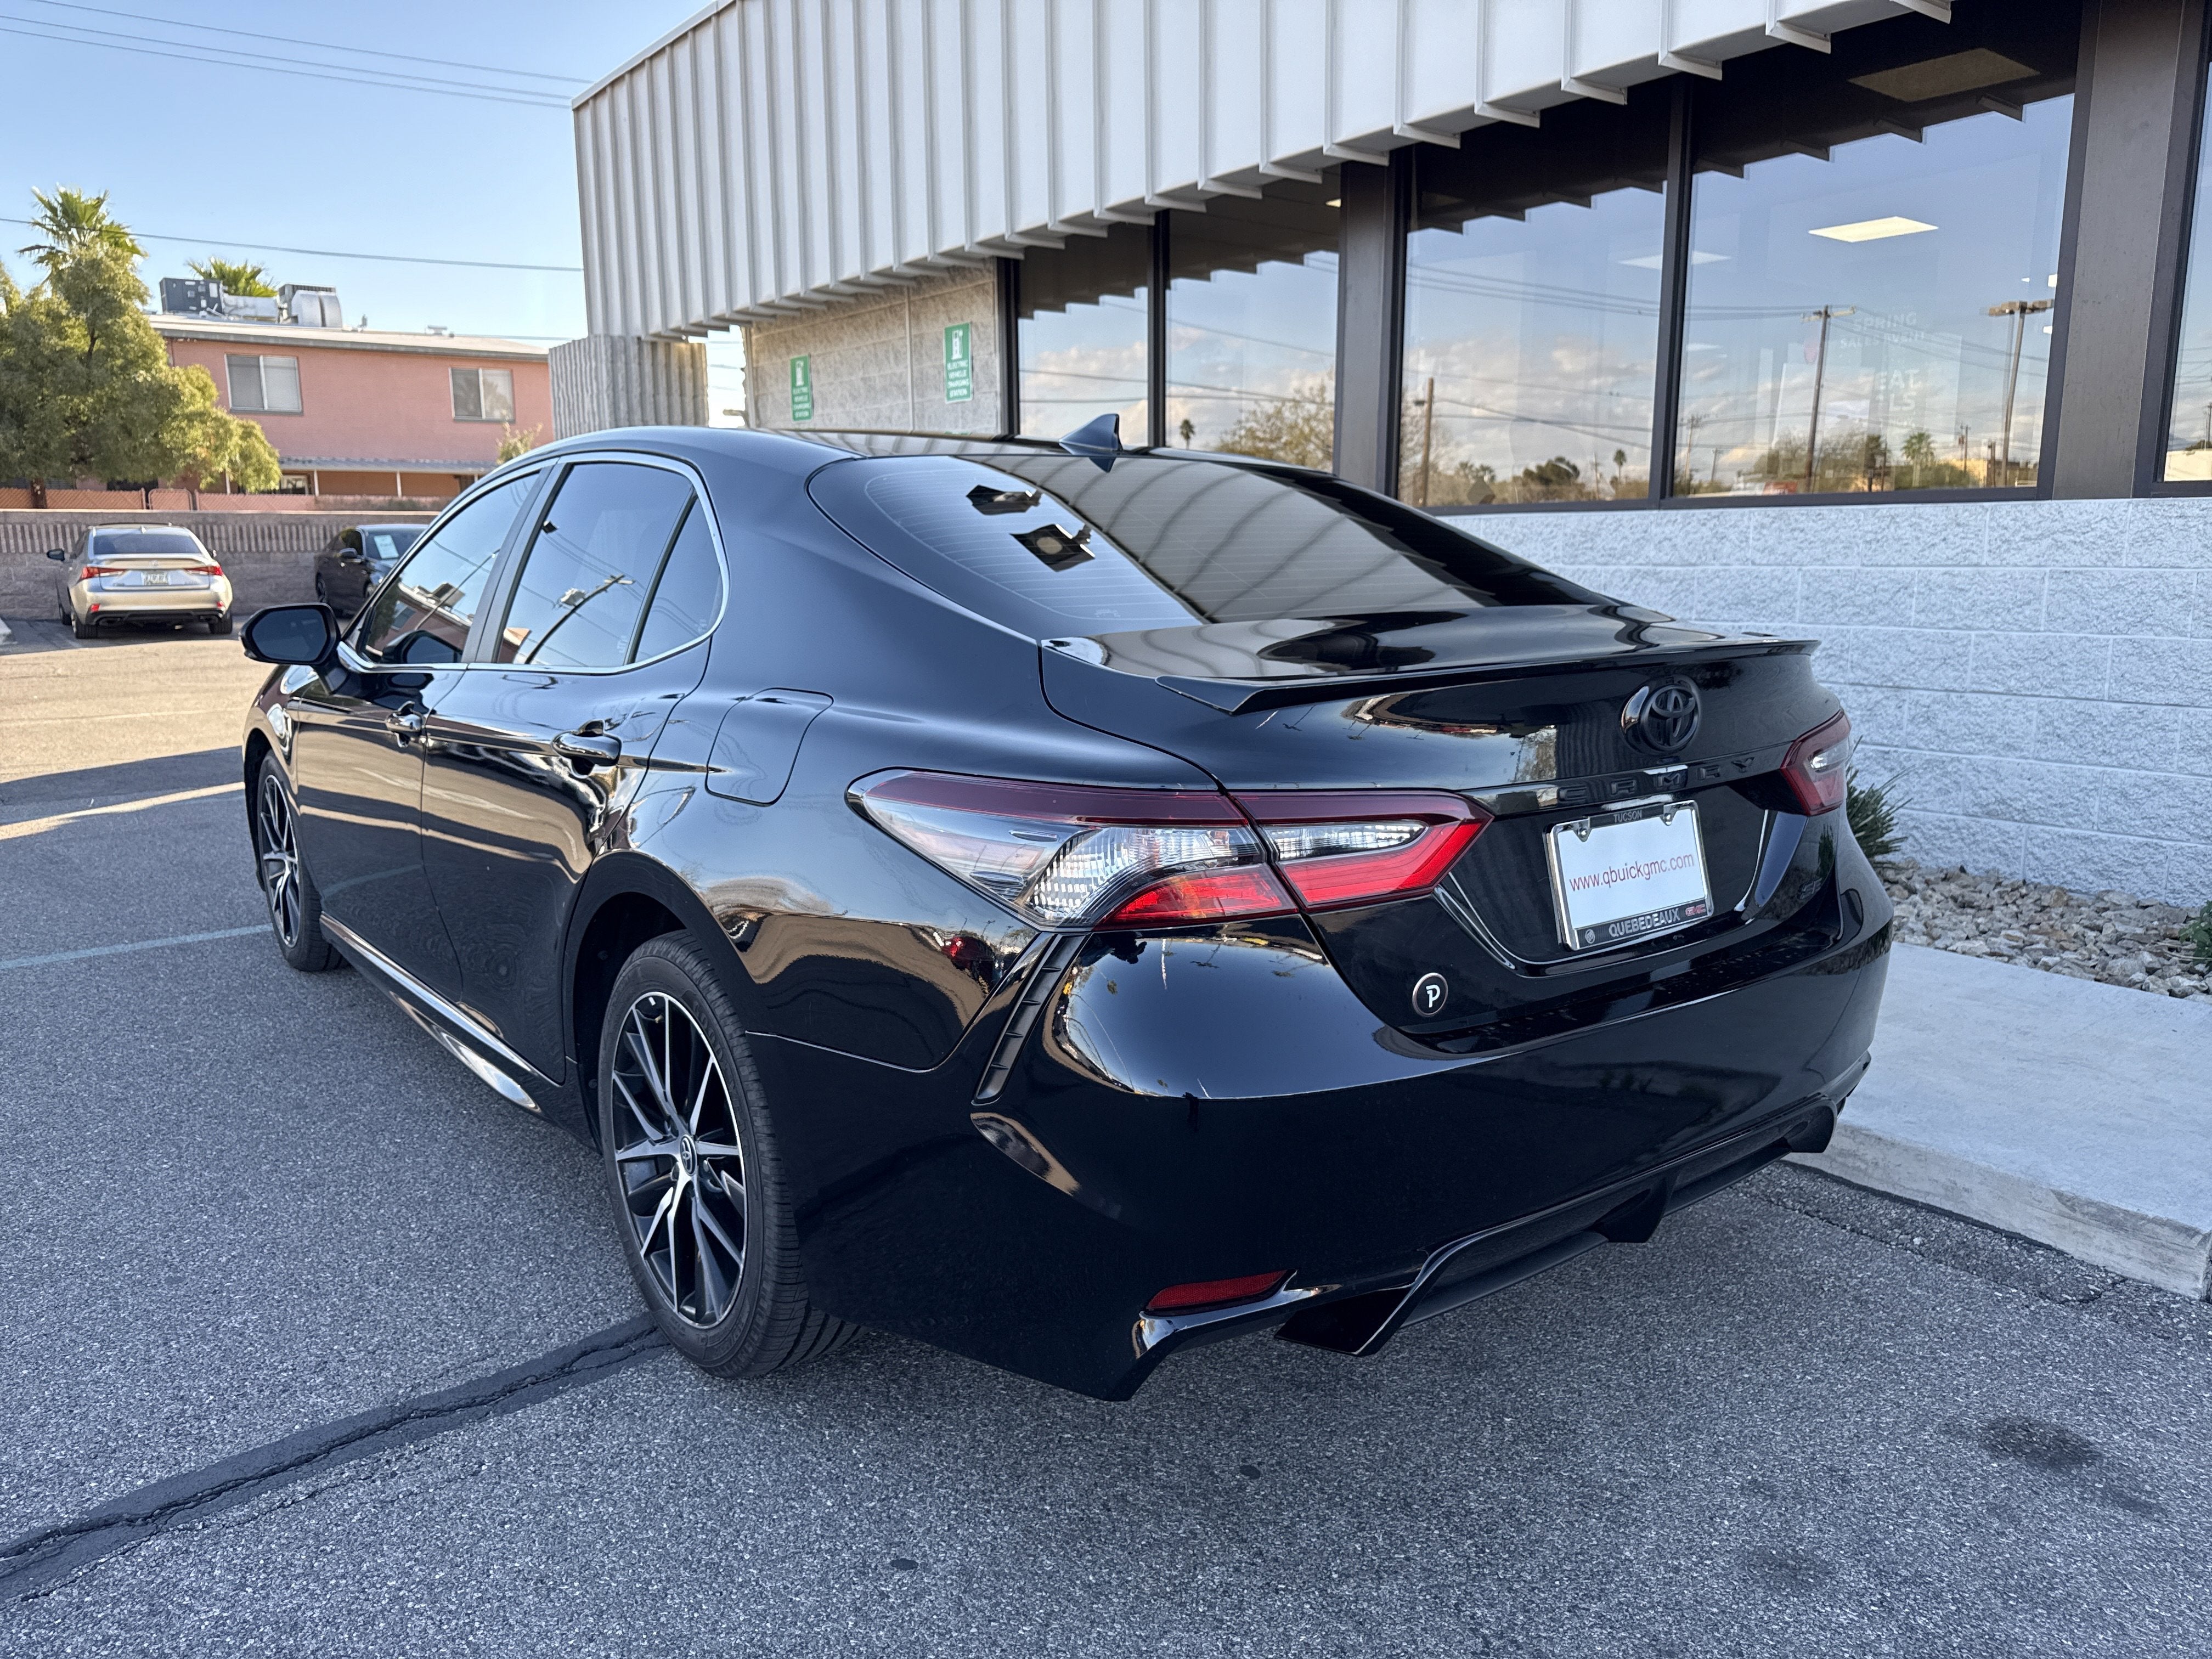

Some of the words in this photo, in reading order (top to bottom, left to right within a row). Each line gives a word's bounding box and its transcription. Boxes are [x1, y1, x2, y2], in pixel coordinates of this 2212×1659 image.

[1558, 757, 1755, 803] CAMRY
[1613, 809, 1643, 823] TUCSON
[1569, 854, 1695, 891] www.qbuickgmc.com
[1609, 907, 1681, 937] QUEBEDEAUX
[1685, 904, 1706, 917] GMC
